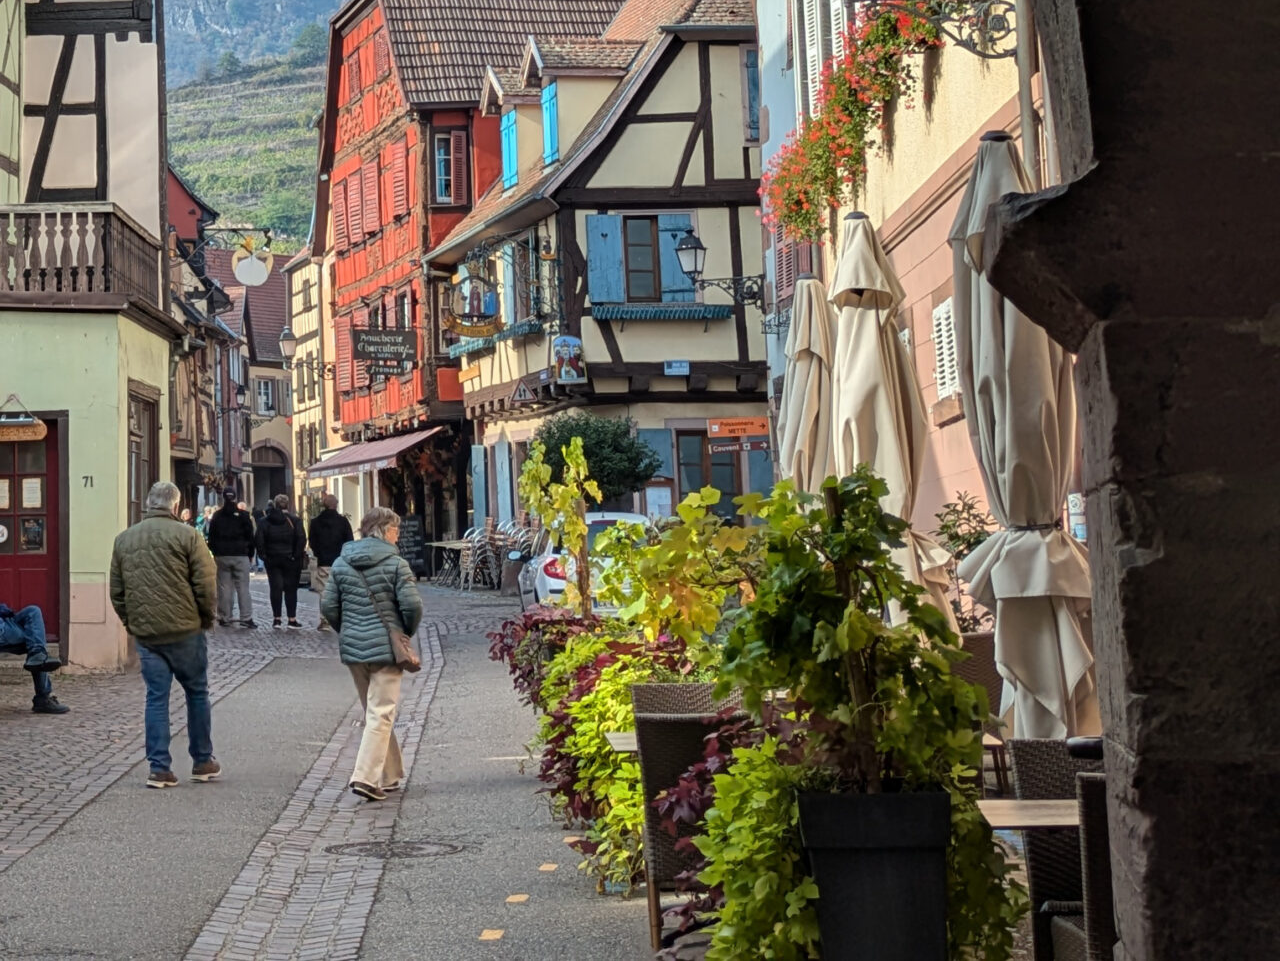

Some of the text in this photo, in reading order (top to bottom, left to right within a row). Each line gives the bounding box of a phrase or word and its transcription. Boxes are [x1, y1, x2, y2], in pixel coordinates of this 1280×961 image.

[359, 333, 403, 342] Boucherie
[357, 342, 405, 352] Charcuterie
[713, 444, 739, 452] Couvent
[82, 476, 94, 488] 71
